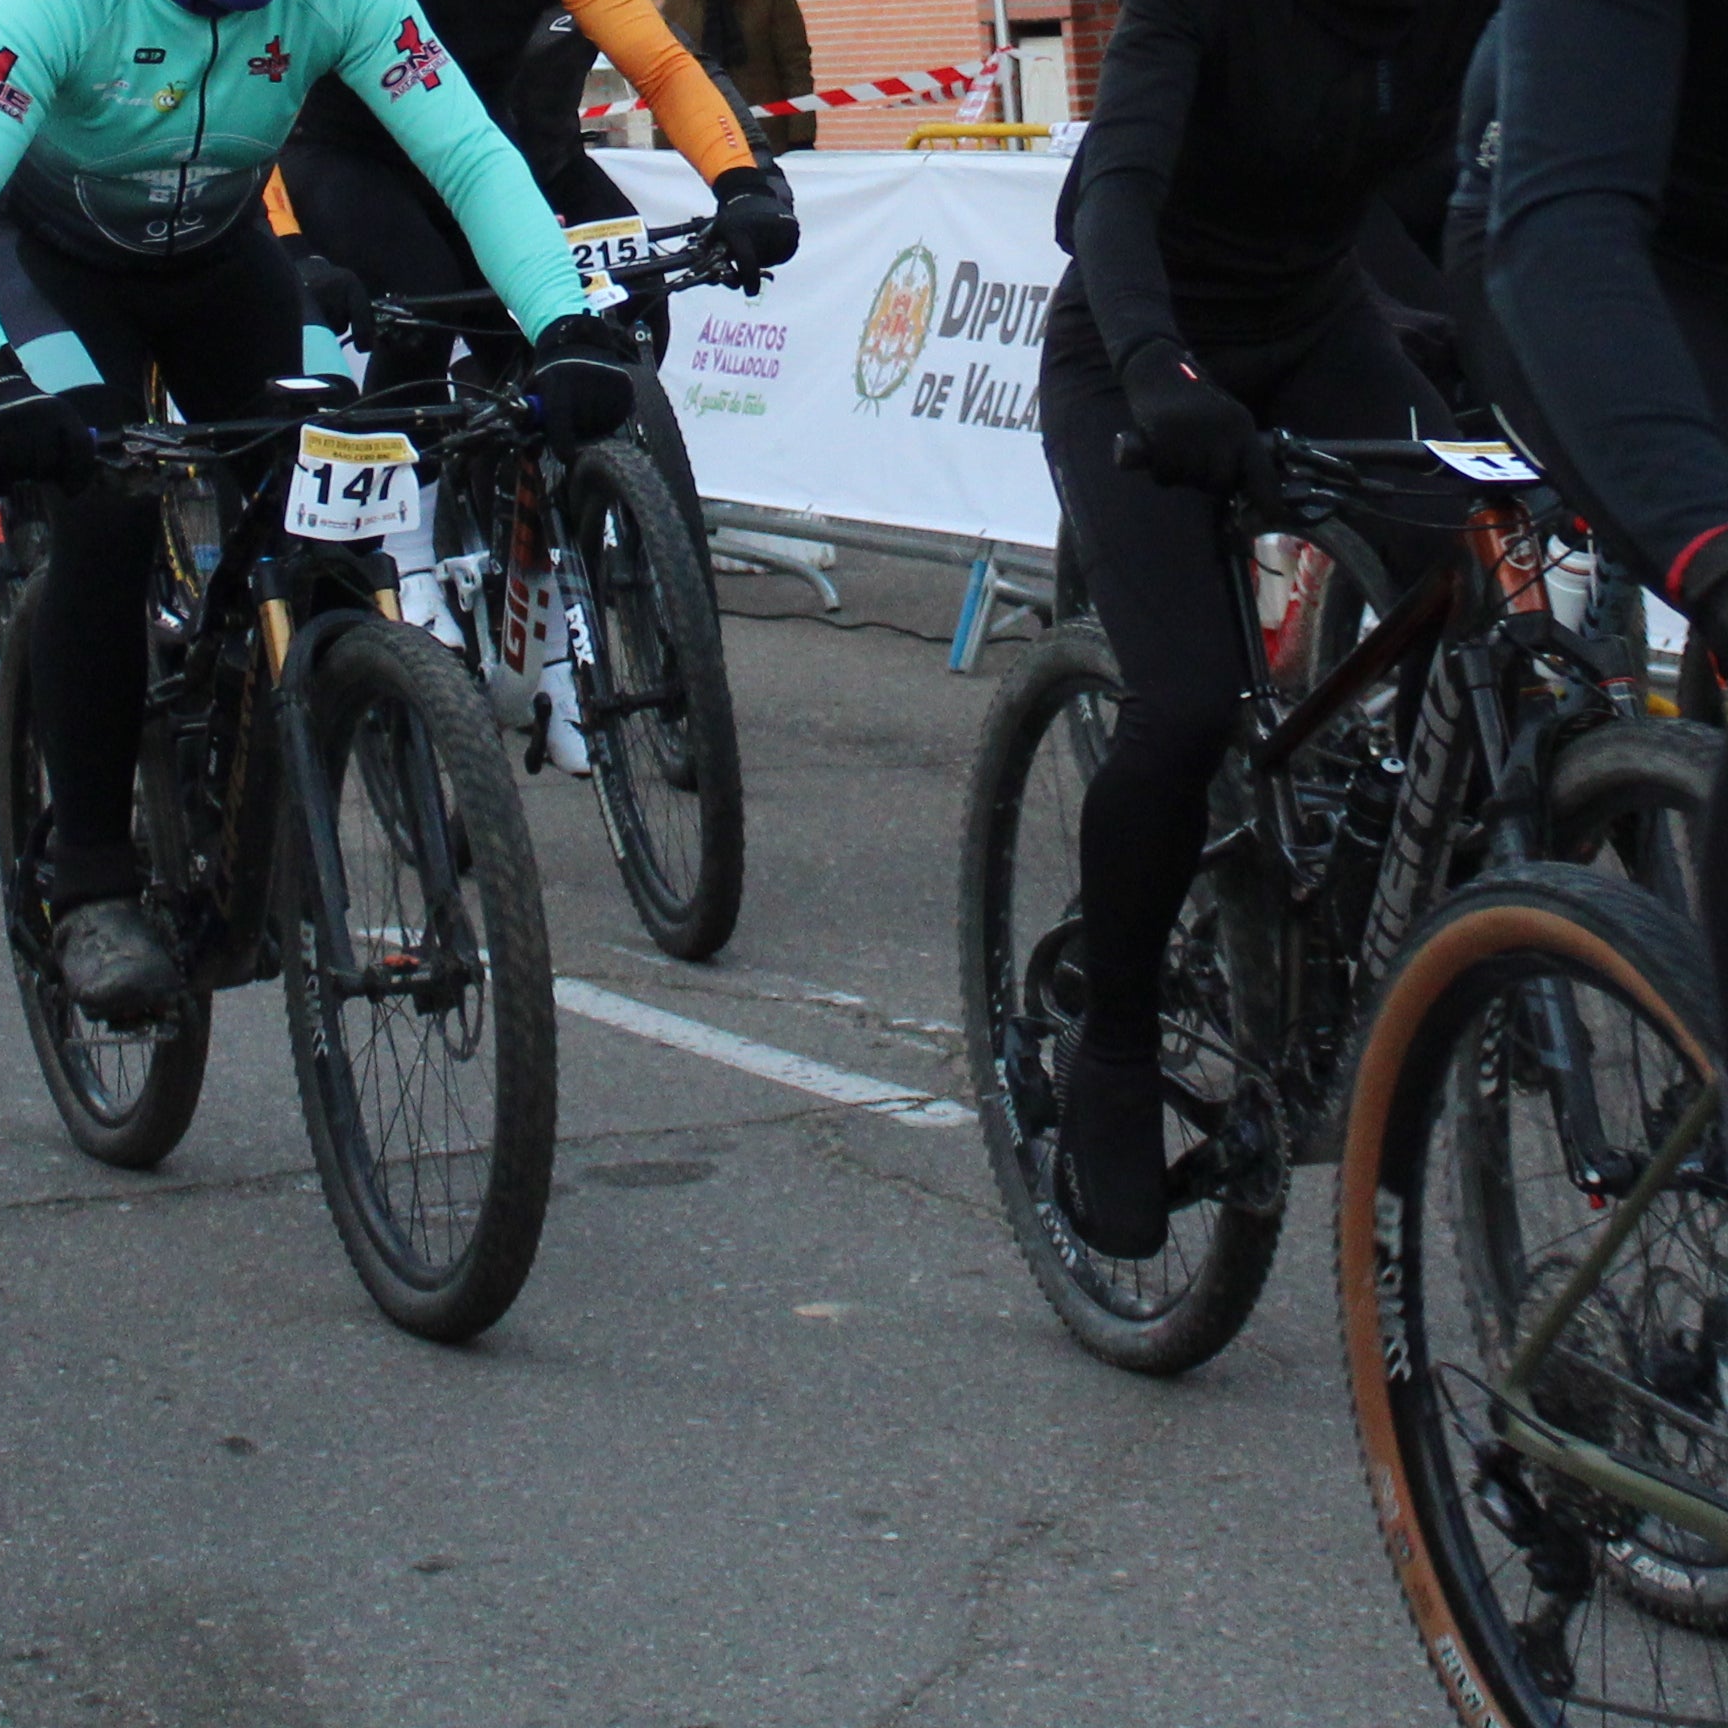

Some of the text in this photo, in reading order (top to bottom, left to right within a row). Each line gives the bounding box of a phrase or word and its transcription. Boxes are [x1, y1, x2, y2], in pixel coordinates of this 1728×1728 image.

[381, 38, 442, 90] ONE
[572, 237, 638, 269] 215
[938, 261, 1058, 347] DIPUT
[698, 313, 787, 351] ALIMENTOS
[691, 348, 780, 379] DE VALLADOLID
[911, 362, 1044, 434] DE VALLA
[312, 463, 399, 507] 147
[564, 603, 596, 668] FOX
